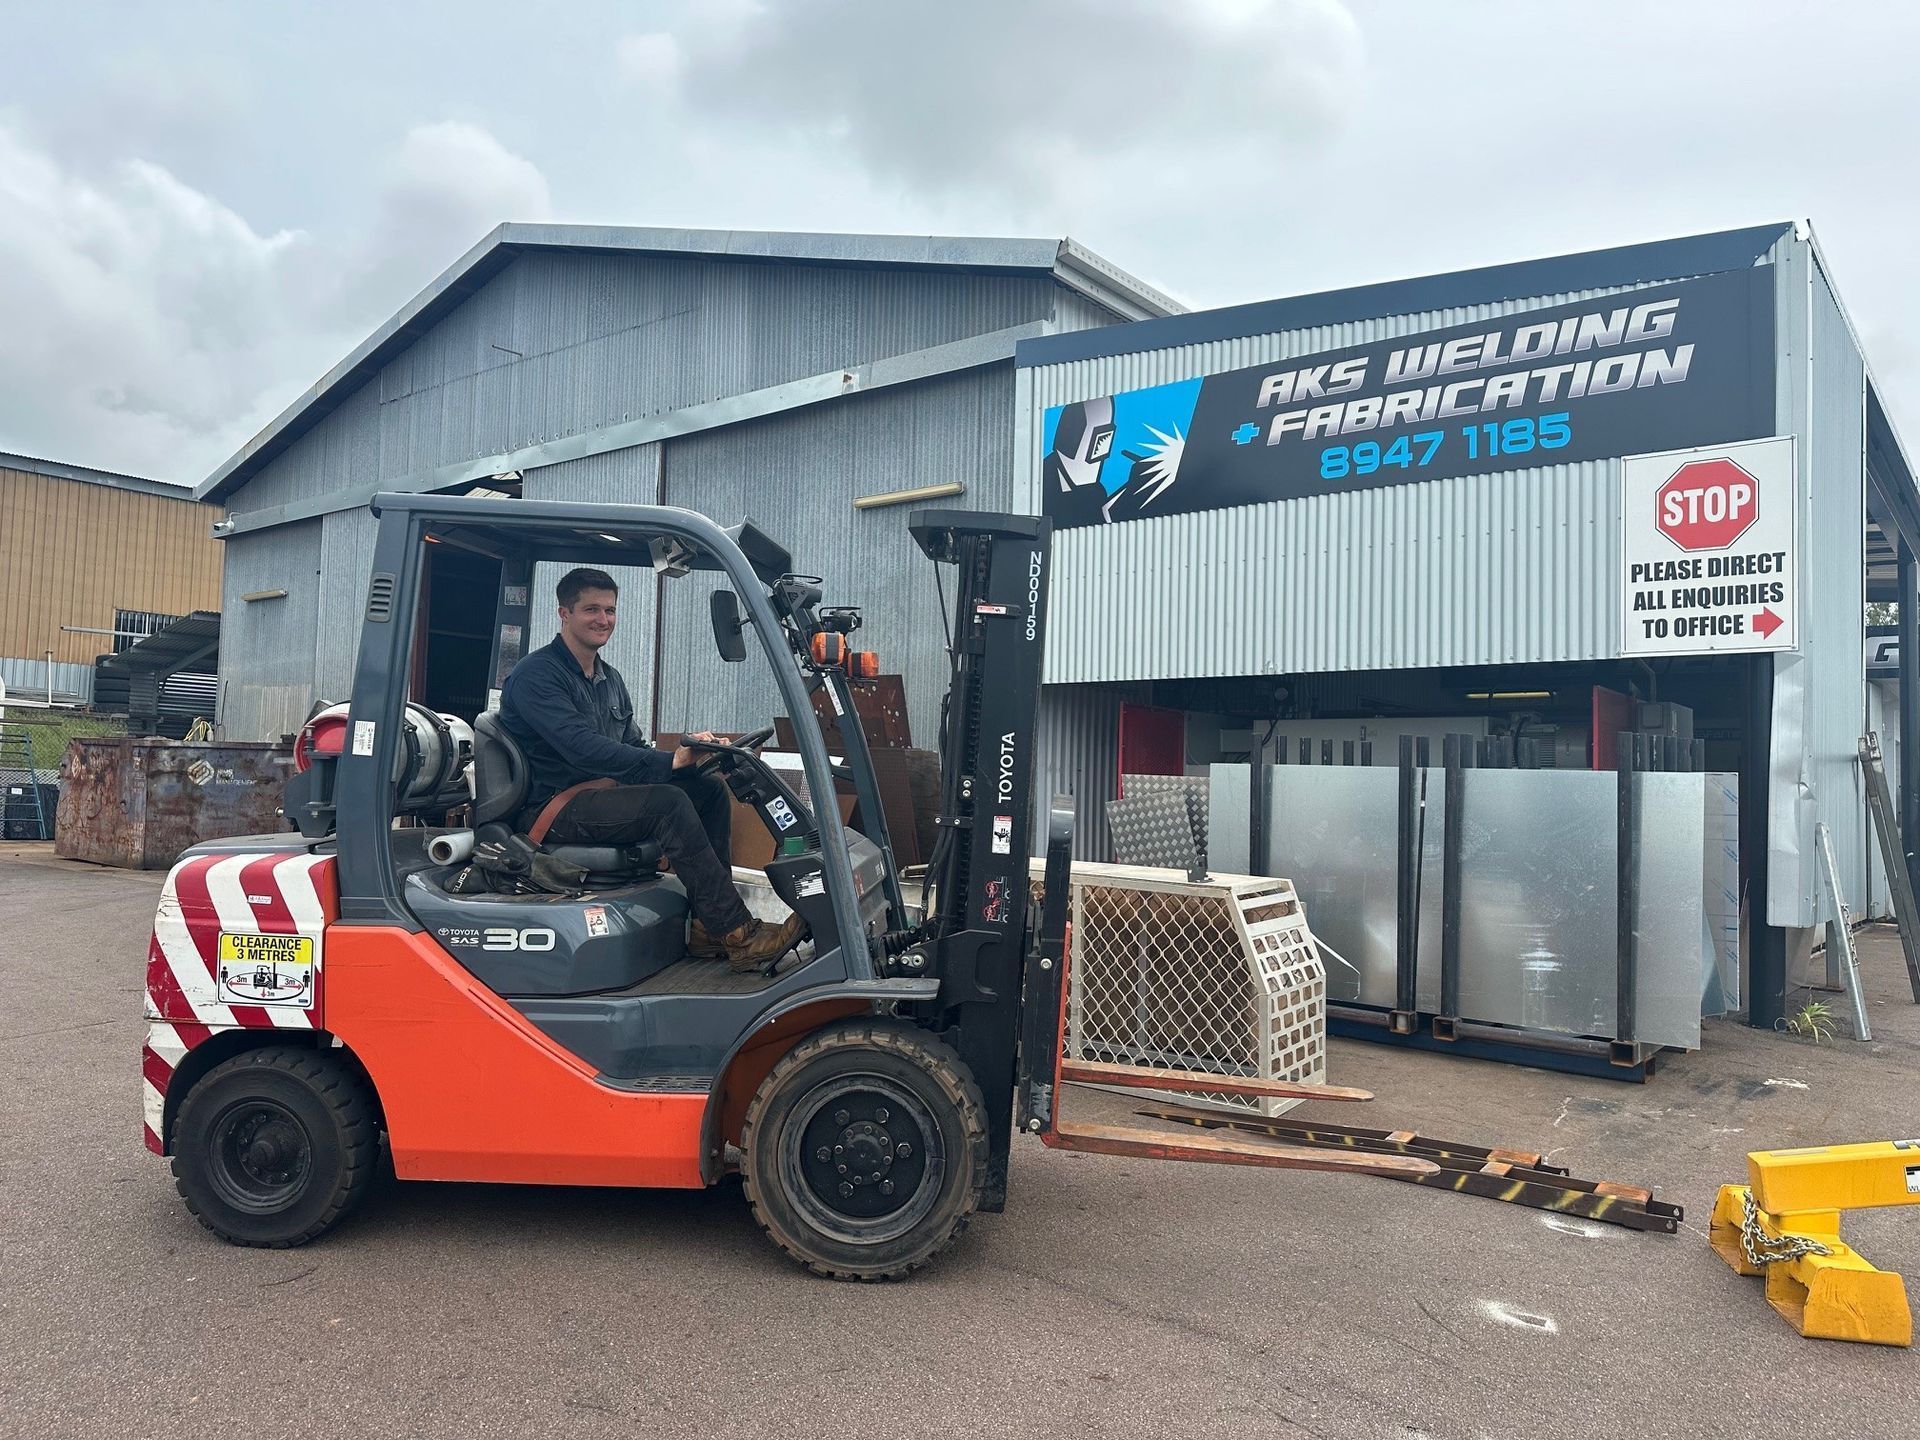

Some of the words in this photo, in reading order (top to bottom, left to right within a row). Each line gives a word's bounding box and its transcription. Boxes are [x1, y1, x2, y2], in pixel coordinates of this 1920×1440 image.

[1256, 357, 1369, 408] AKS
[1384, 298, 1680, 385] WELDING
[1267, 344, 1695, 446] FABRICATION
[1320, 430, 1444, 479] 8947
[1462, 412, 1571, 459] 1185
[1663, 483, 1751, 527] STOP
[1631, 559, 1702, 583] PLEASE
[1708, 552, 1786, 578] DIRECT
[1026, 551, 1042, 641] ND00159
[1633, 590, 1667, 611] ALL
[1672, 582, 1784, 609] ENQUIRIES
[1643, 618, 1668, 639] TO
[1674, 614, 1744, 638] OFFICE
[998, 732, 1015, 804] TOYOTA
[232, 936, 302, 950] CLEARANCE
[482, 928, 556, 951] 30
[237, 949, 244, 960] 3
[248, 949, 295, 962] METRES
[237, 975, 247, 983] 3m
[285, 978, 296, 986] 3m
